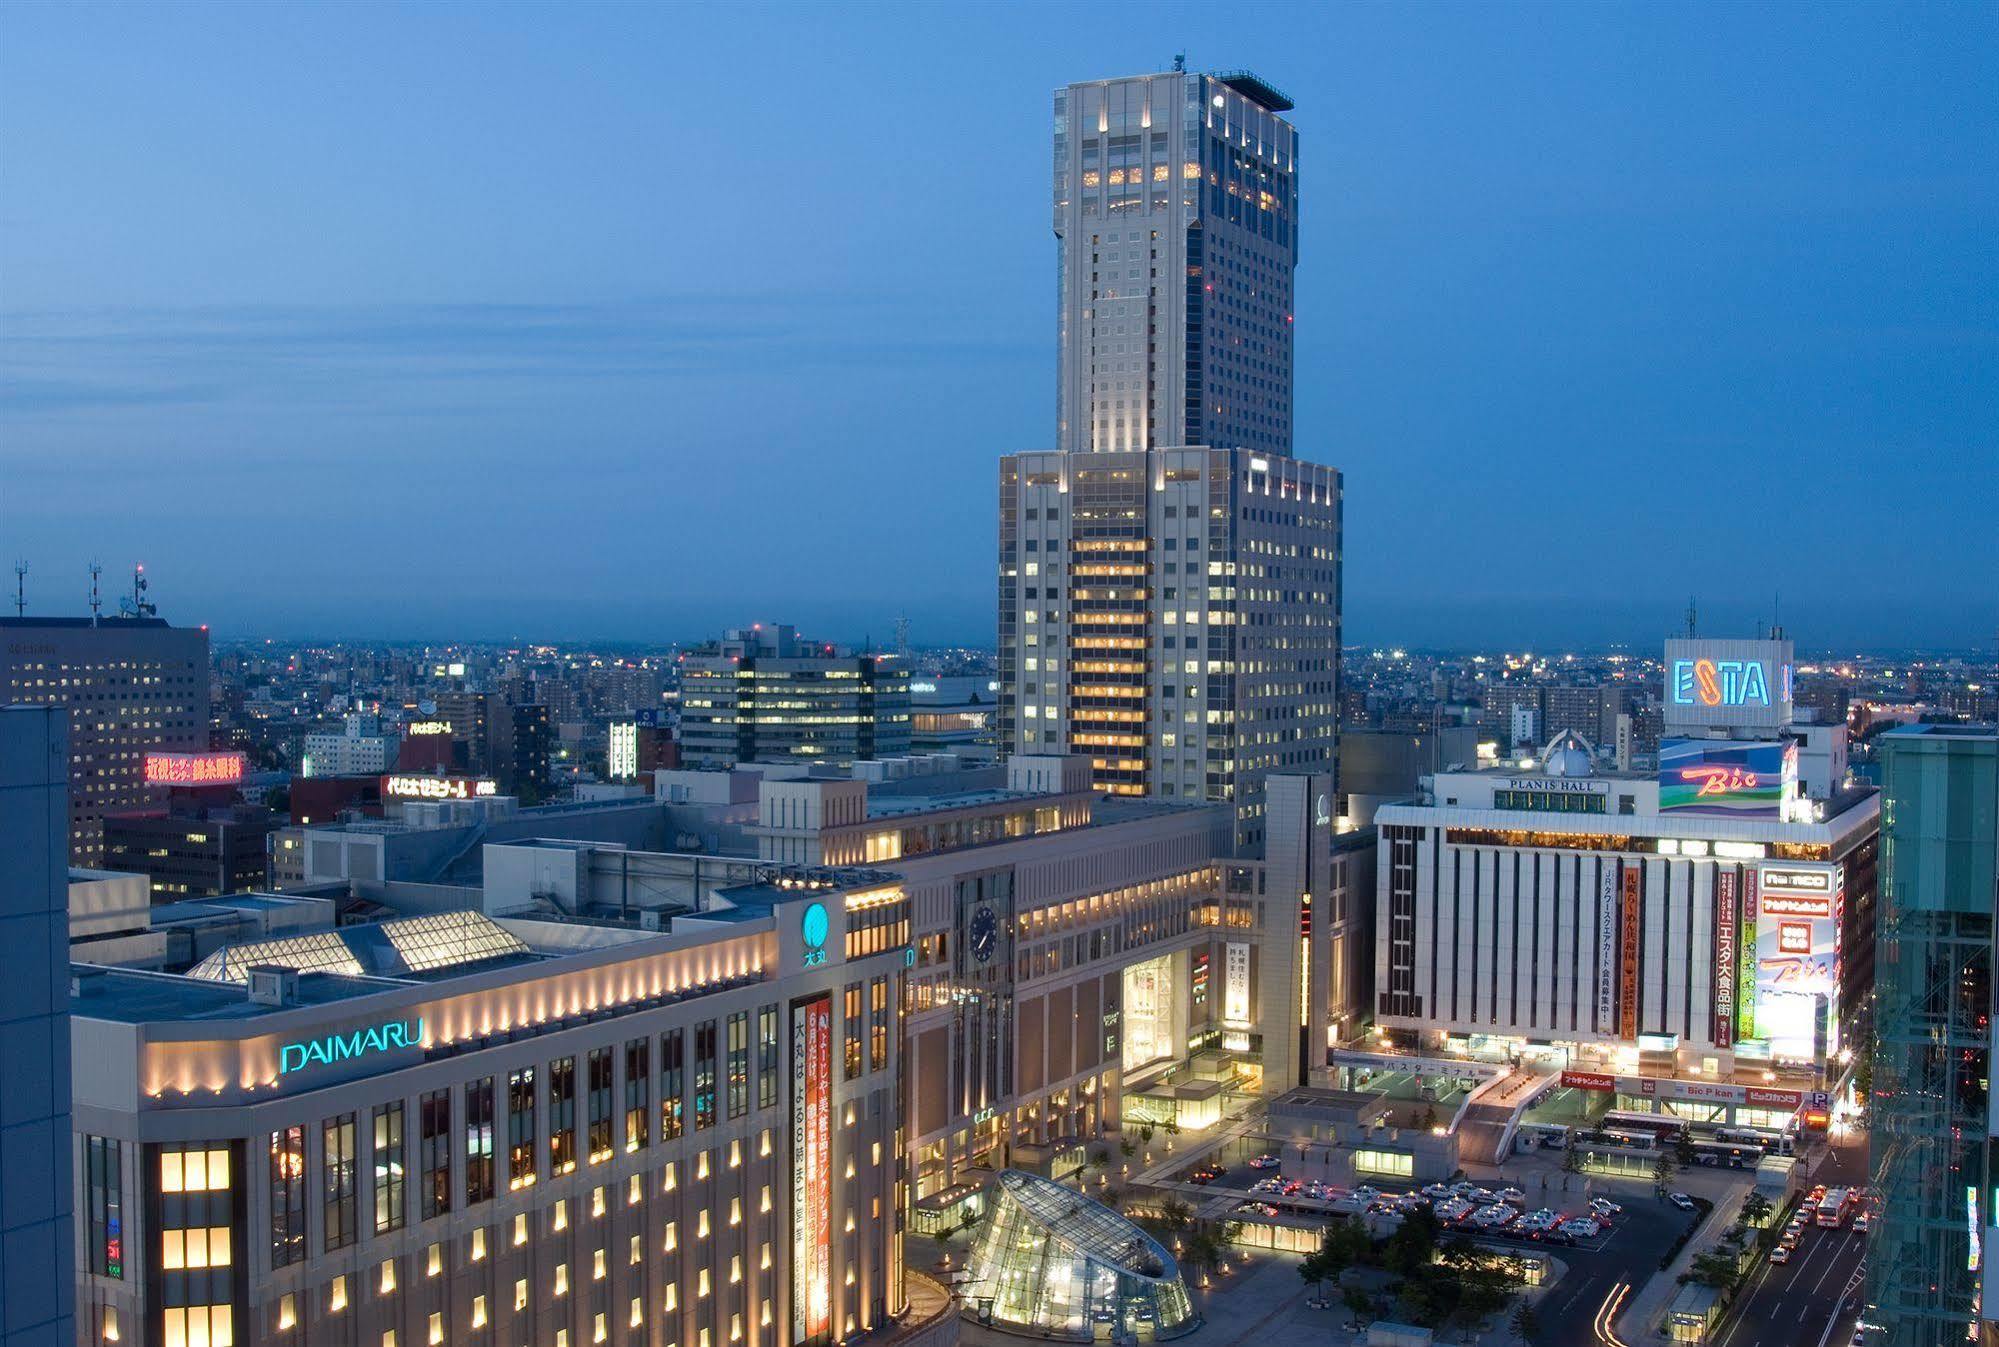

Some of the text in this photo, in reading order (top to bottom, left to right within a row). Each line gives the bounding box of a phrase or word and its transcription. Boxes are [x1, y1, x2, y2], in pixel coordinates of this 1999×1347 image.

[1674, 659, 1770, 706] ESTA
[1510, 780, 1594, 791] PLANIS HALL
[1681, 767, 1757, 797] Bic
[803, 950, 826, 968] 大丸
[1717, 926, 1732, 1017] エスタ大食品街
[280, 1017, 424, 1075] DAIMARU
[1386, 1063, 1476, 1078] バスターミナル
[1687, 1087, 1703, 1095] Bic
[1715, 1088, 1733, 1098] kan
[1750, 1091, 1797, 1103] ビックカメラ
[1815, 1093, 1826, 1104] P
